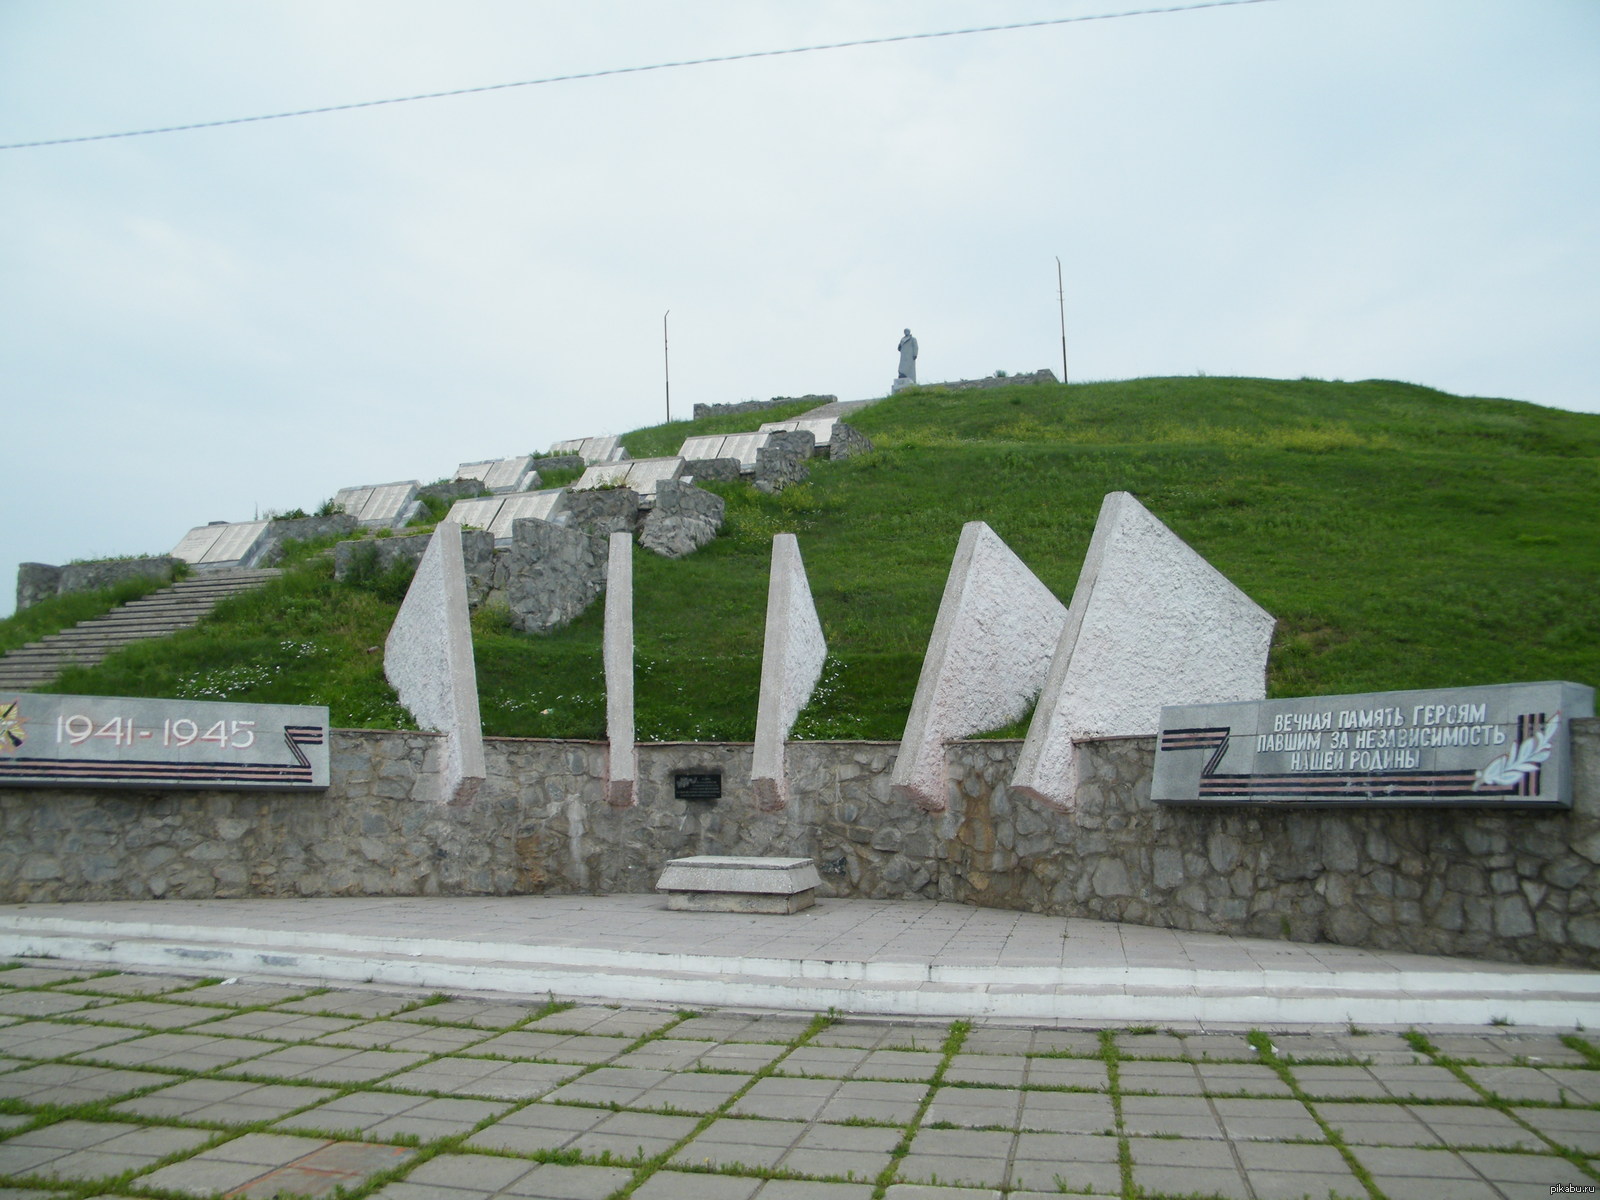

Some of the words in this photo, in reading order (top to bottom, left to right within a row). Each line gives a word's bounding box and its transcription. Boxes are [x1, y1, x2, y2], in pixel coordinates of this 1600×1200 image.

[1274, 711, 1333, 732] ВЕЧНАЯ
[1338, 706, 1405, 729] ПАМЯТЬ
[1412, 703, 1487, 726] ГЕРОЯМ
[1257, 732, 1322, 753] ПАВШИМ
[1330, 731, 1349, 750] ЗА
[1355, 725, 1506, 750] НЕЗАВИСИМОСТЬ
[1291, 749, 1345, 771] НАШЕЙ
[1349, 749, 1420, 771] РОДИНЫ
